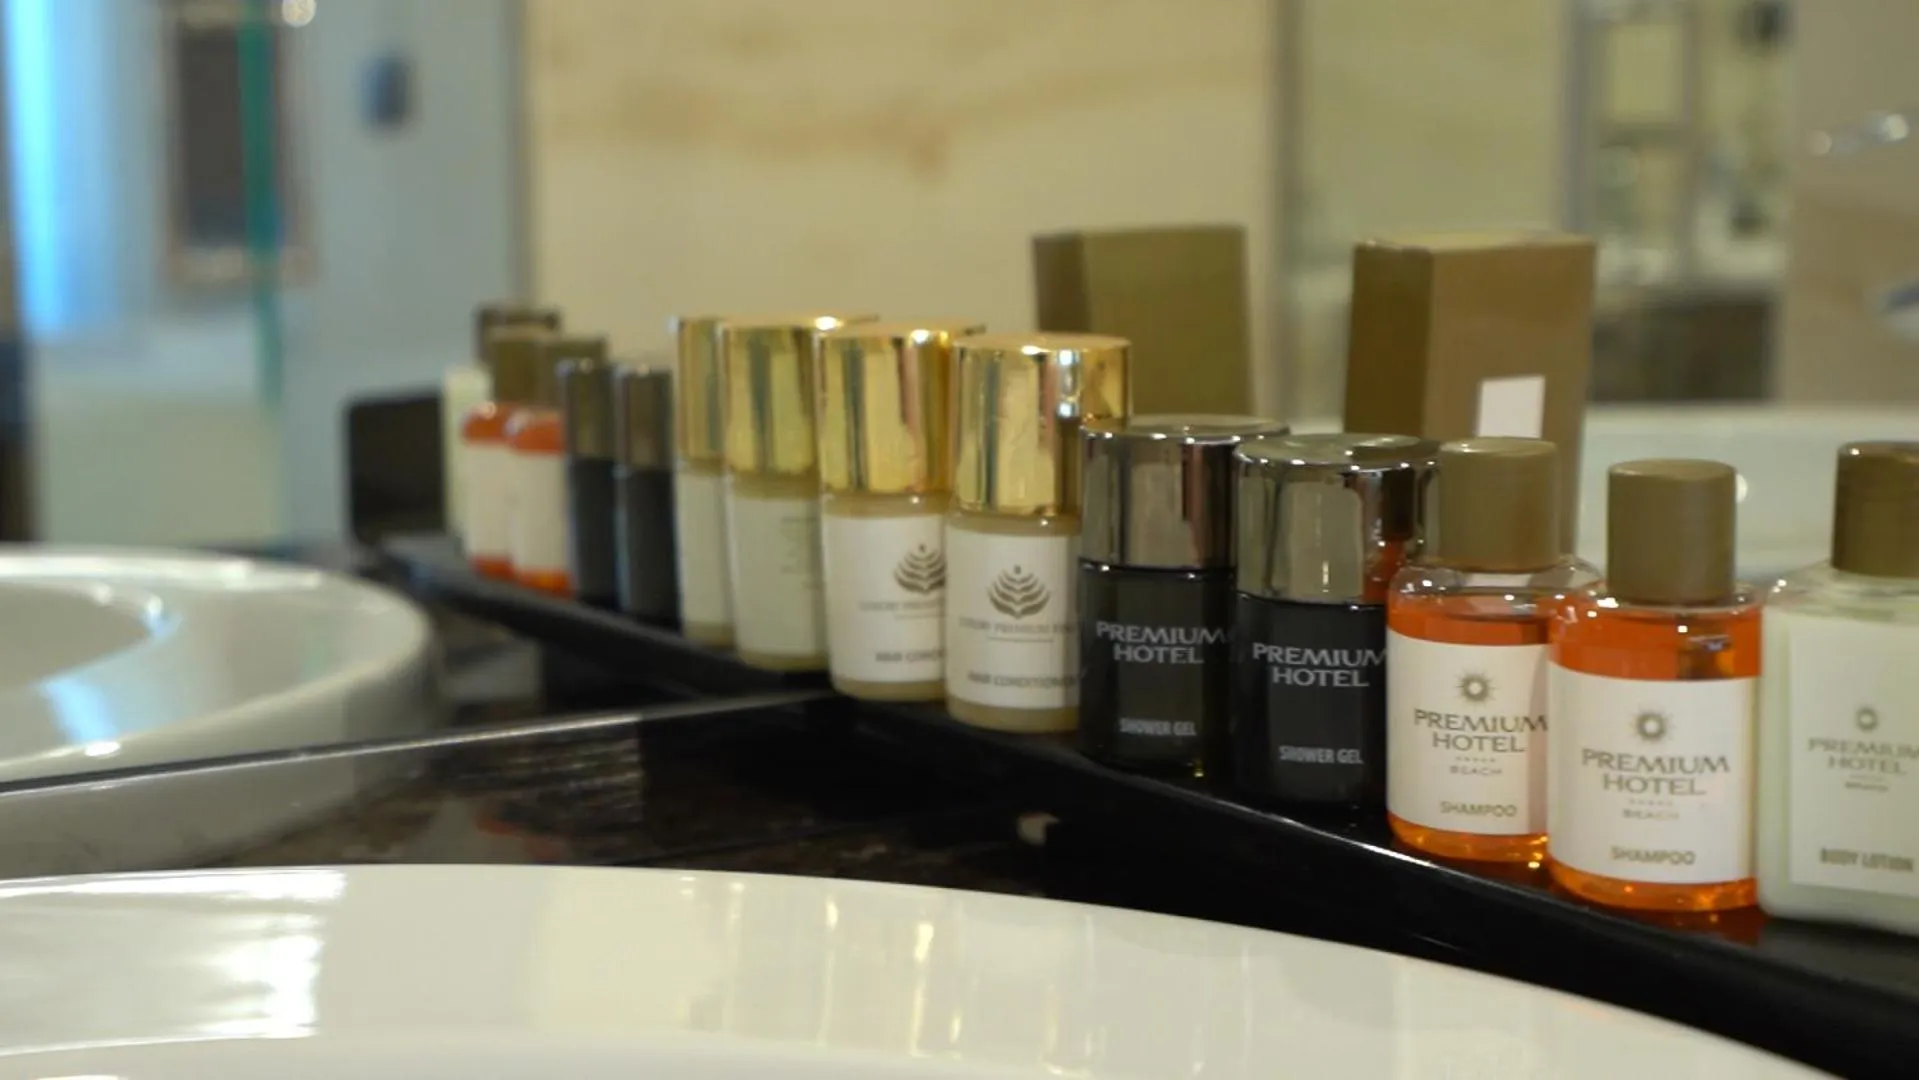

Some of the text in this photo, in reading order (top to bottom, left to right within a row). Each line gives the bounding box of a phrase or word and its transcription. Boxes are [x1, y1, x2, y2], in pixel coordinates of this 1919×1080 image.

[1096, 621, 1226, 644] PREMIUM
[1113, 644, 1205, 664] HOTEL
[1252, 642, 1386, 667] PREMIUM
[1273, 665, 1370, 687] HOTEL
[1119, 718, 1197, 736] SHOWER GEL
[1414, 708, 1548, 733] PREMIUM
[1432, 731, 1525, 753] HOTEL
[1279, 745, 1364, 765] SHOWER GEL
[1582, 748, 1731, 775] PREMIUM
[1829, 755, 1907, 775] HOTEL
[1450, 765, 1503, 776] BEACH
[1603, 773, 1707, 796] HOTEL
[1440, 801, 1517, 818] SHAMPOO
[1623, 809, 1680, 820] BEACH
[1611, 845, 1696, 866] SHAMPOO
[1820, 848, 1914, 873] BODY LOTION
